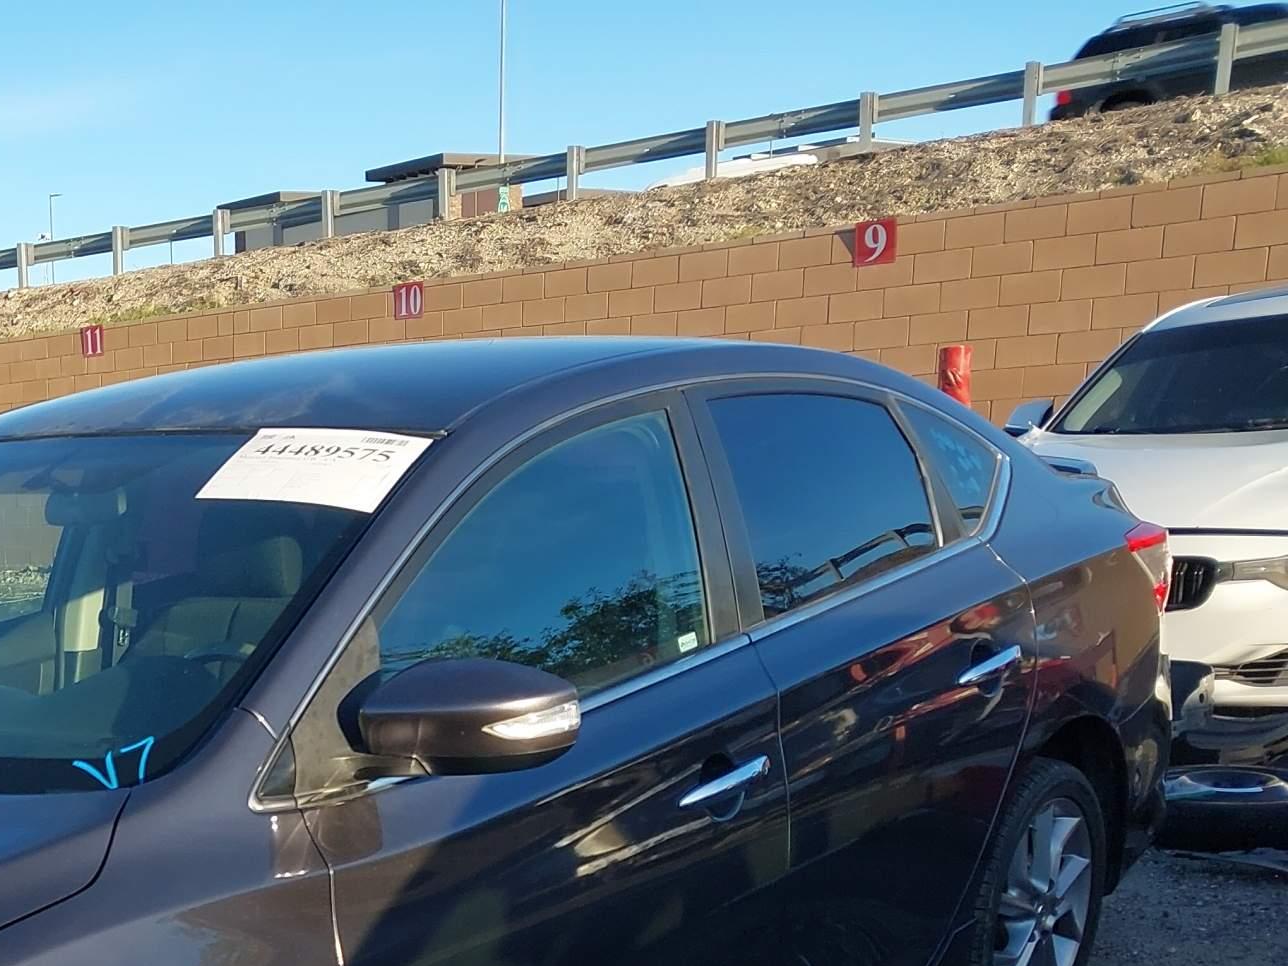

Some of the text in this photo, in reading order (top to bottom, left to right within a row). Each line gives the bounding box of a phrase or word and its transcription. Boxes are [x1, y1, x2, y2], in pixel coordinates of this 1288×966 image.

[863, 223, 887, 262] 9
[399, 284, 421, 316] 10
[85, 326, 103, 355] 11
[254, 443, 396, 462] 44489575
